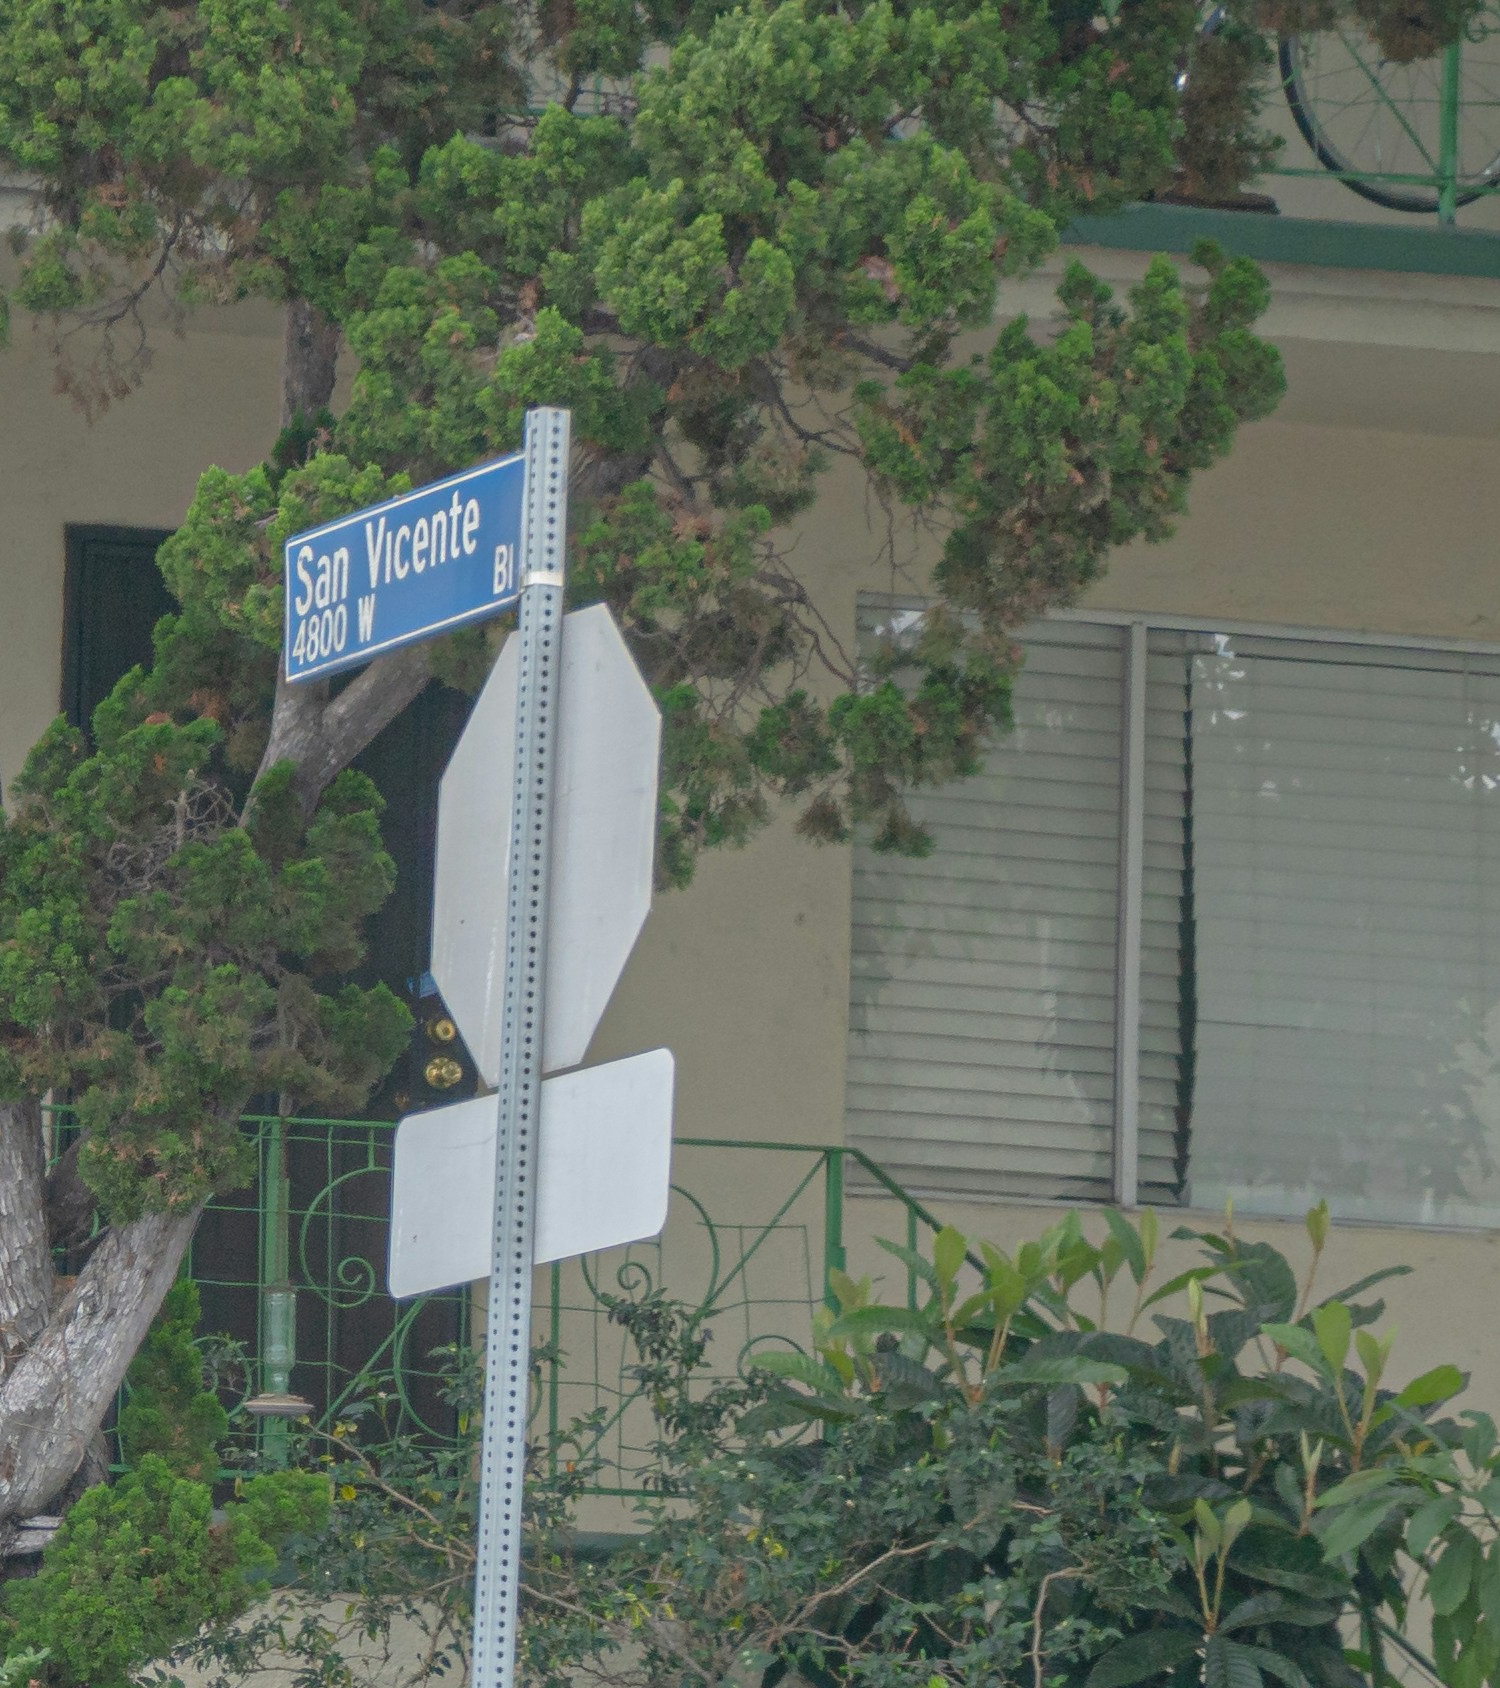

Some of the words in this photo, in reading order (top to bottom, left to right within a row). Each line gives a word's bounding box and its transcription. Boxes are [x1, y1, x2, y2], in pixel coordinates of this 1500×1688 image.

[295, 545, 349, 616] San
[366, 490, 480, 589] Vicente
[292, 603, 347, 665] 4800
[358, 594, 375, 643] W
